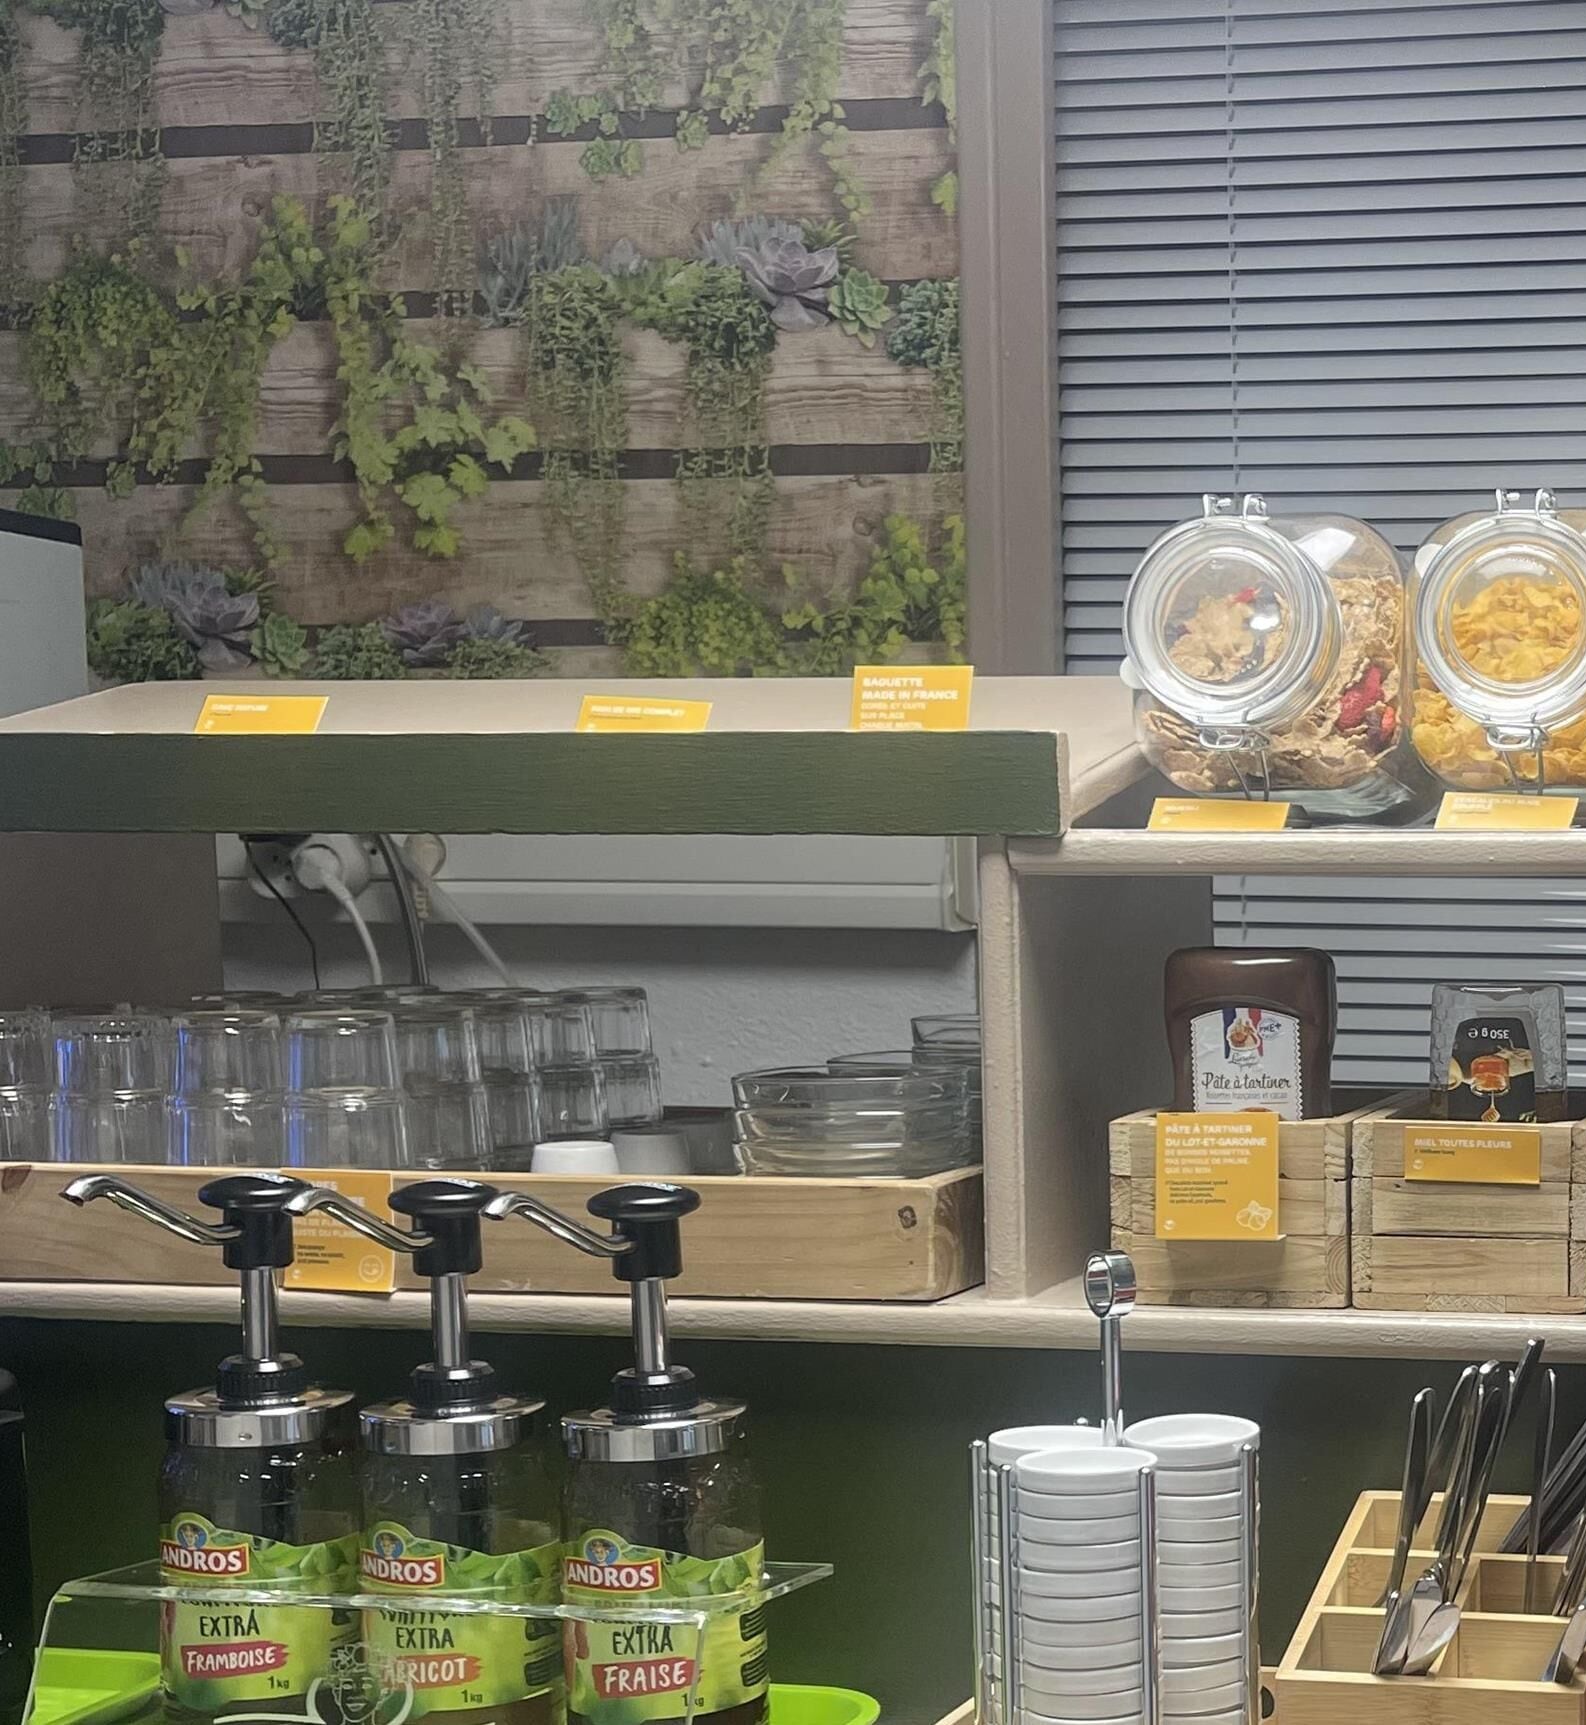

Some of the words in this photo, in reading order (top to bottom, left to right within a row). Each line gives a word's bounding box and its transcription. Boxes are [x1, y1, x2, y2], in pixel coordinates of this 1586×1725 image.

[863, 677, 923, 687] BAGUETTE
[862, 690, 896, 700] MADE
[898, 690, 911, 700] IN
[913, 690, 958, 700] FRANCE
[1490, 1029, 1510, 1039] 350
[1202, 1072, 1231, 1089] Pâte
[1233, 1075, 1243, 1089] à
[1243, 1073, 1291, 1089] tartiner
[1202, 1125, 1252, 1134] TARTINER
[1165, 1138, 1180, 1147] DU
[1182, 1137, 1267, 1147] LOT-ET-GARONNE
[1439, 1139, 1475, 1148] TOUTES
[161, 1545, 242, 1572] ANDROS
[567, 1563, 655, 1588] ANDROS
[199, 1609, 260, 1637] EXTRA
[396, 1627, 455, 1649] EXTRA
[186, 1646, 277, 1673] FRAMBOISE
[383, 1657, 468, 1684] ABRICOT
[604, 1660, 687, 1693] FRAISE
